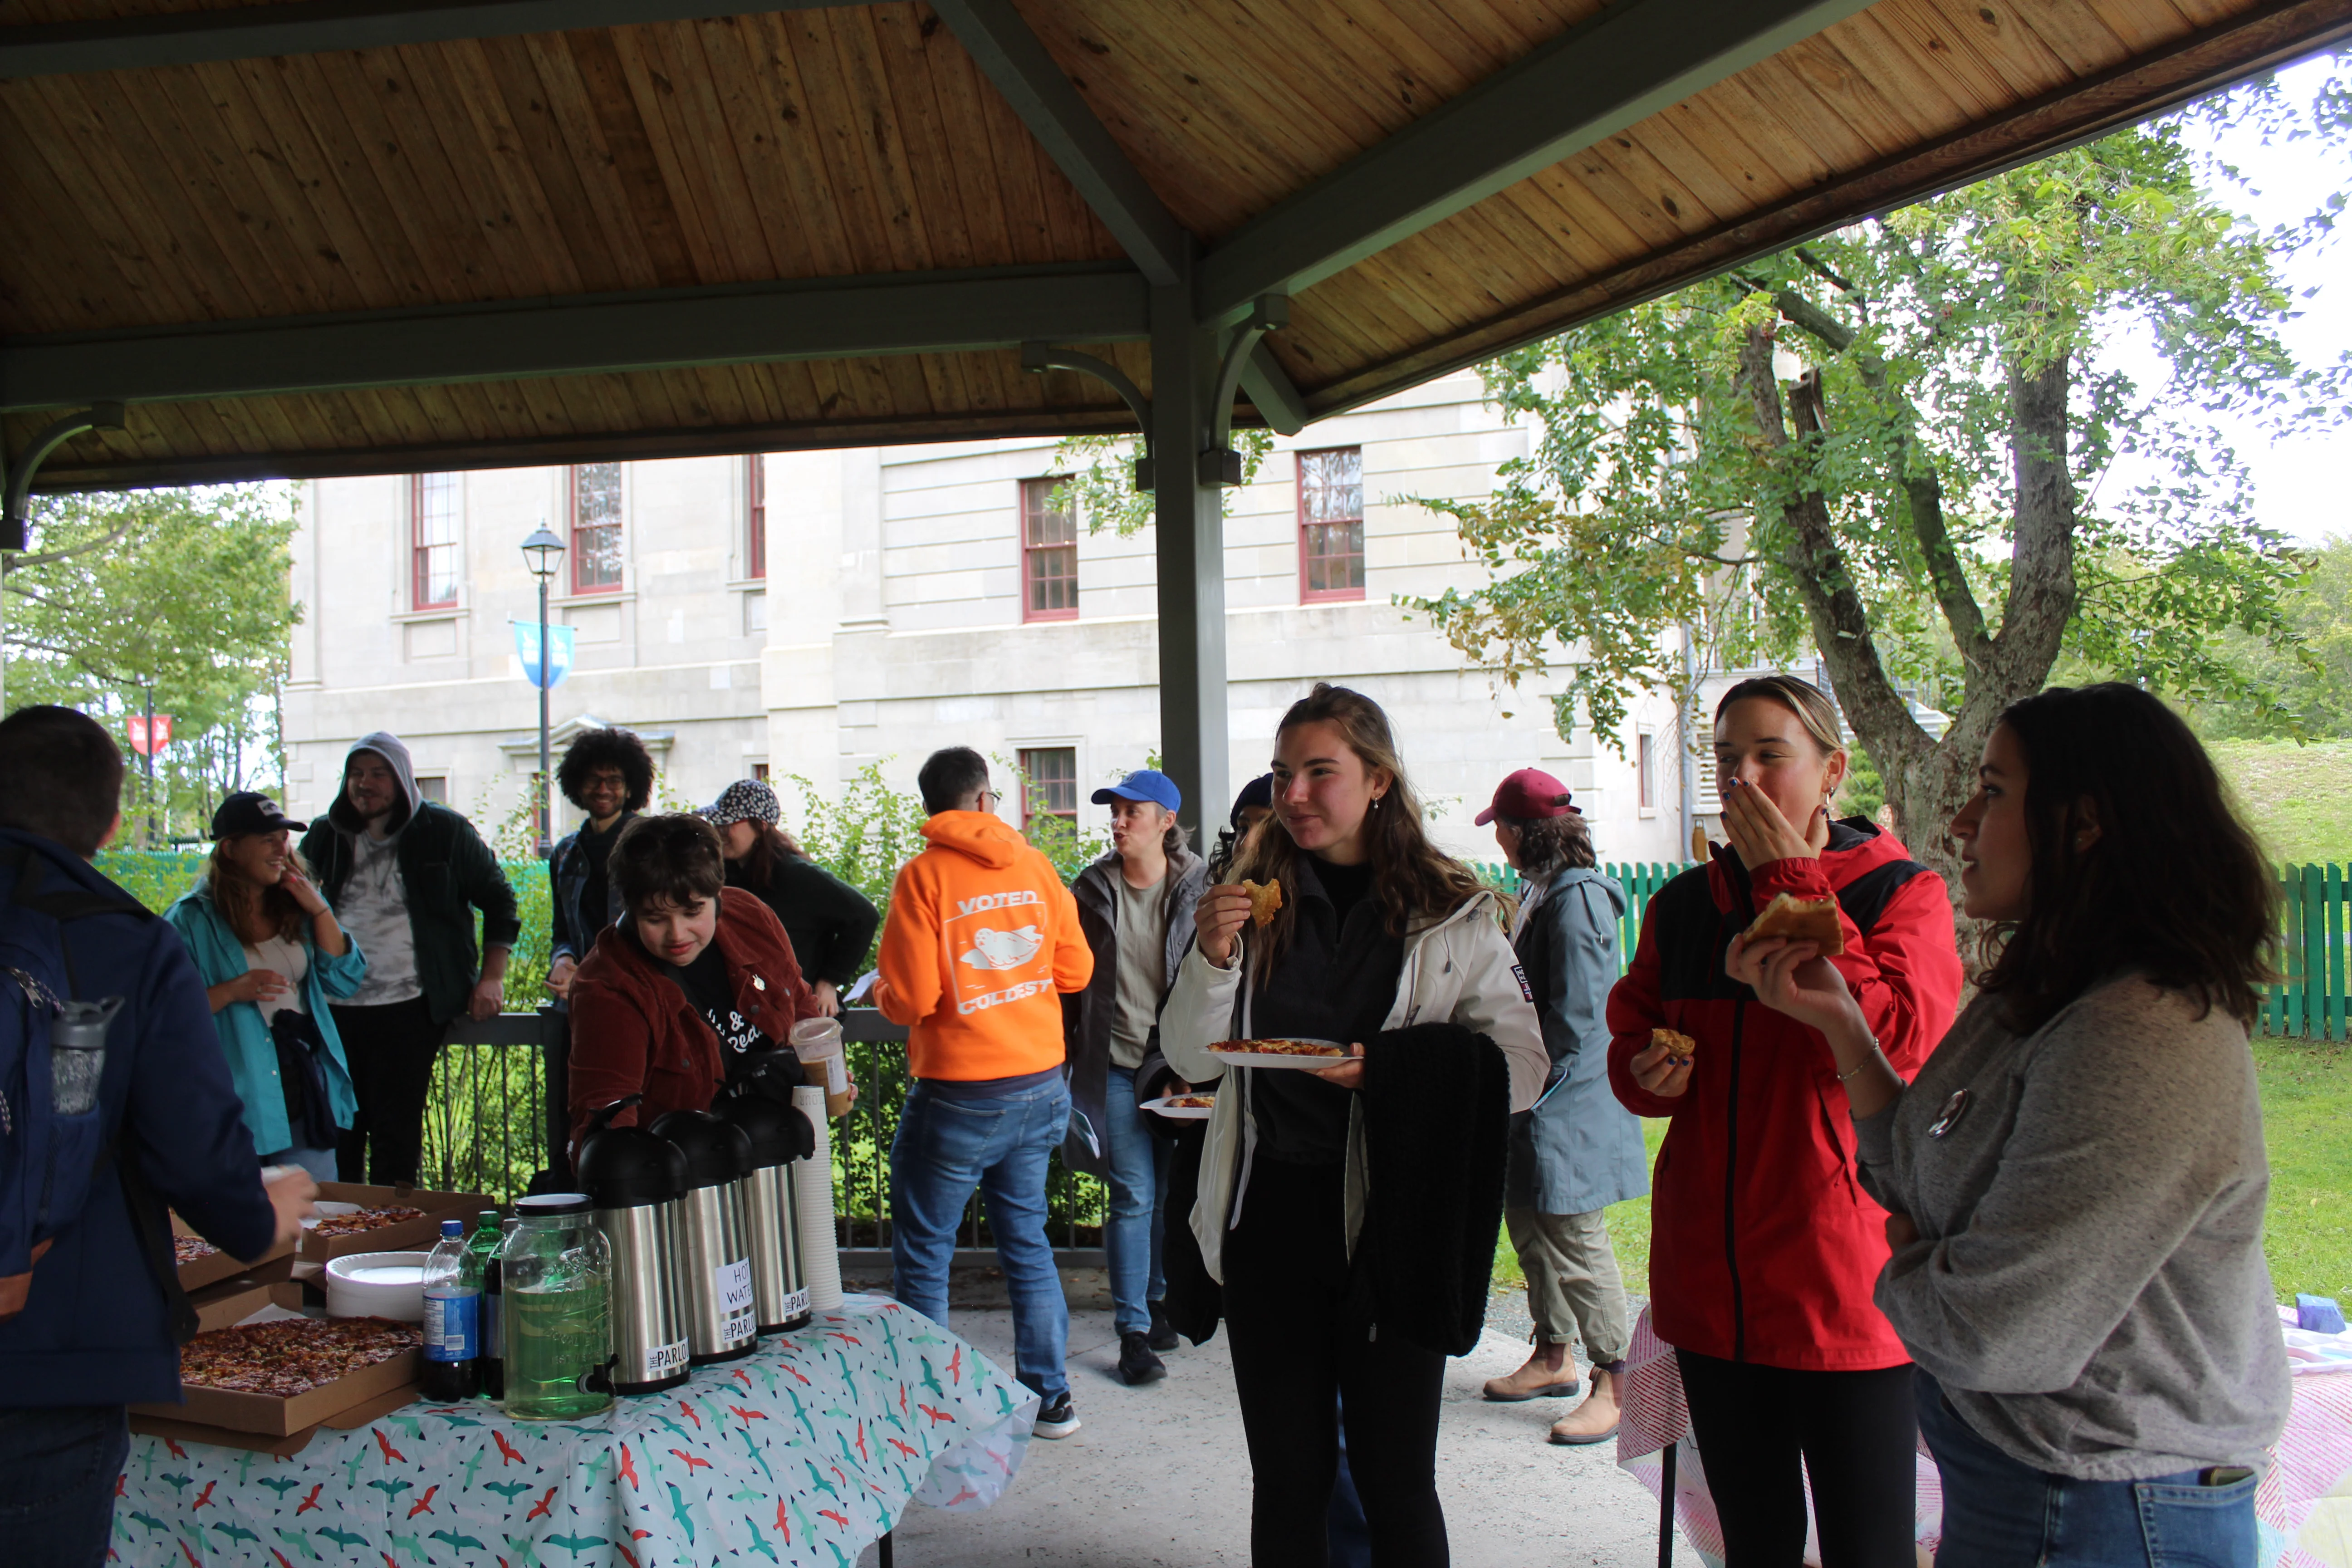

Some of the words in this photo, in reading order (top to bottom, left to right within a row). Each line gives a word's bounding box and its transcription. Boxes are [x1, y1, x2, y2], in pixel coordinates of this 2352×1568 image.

[957, 891, 1038, 915] VOTED
[957, 981, 1053, 1014] COLDEST
[730, 1011, 745, 1032] &
[734, 1263, 749, 1284] HOT
[727, 1281, 752, 1304] WATE
[649, 1356, 657, 1369] THE
